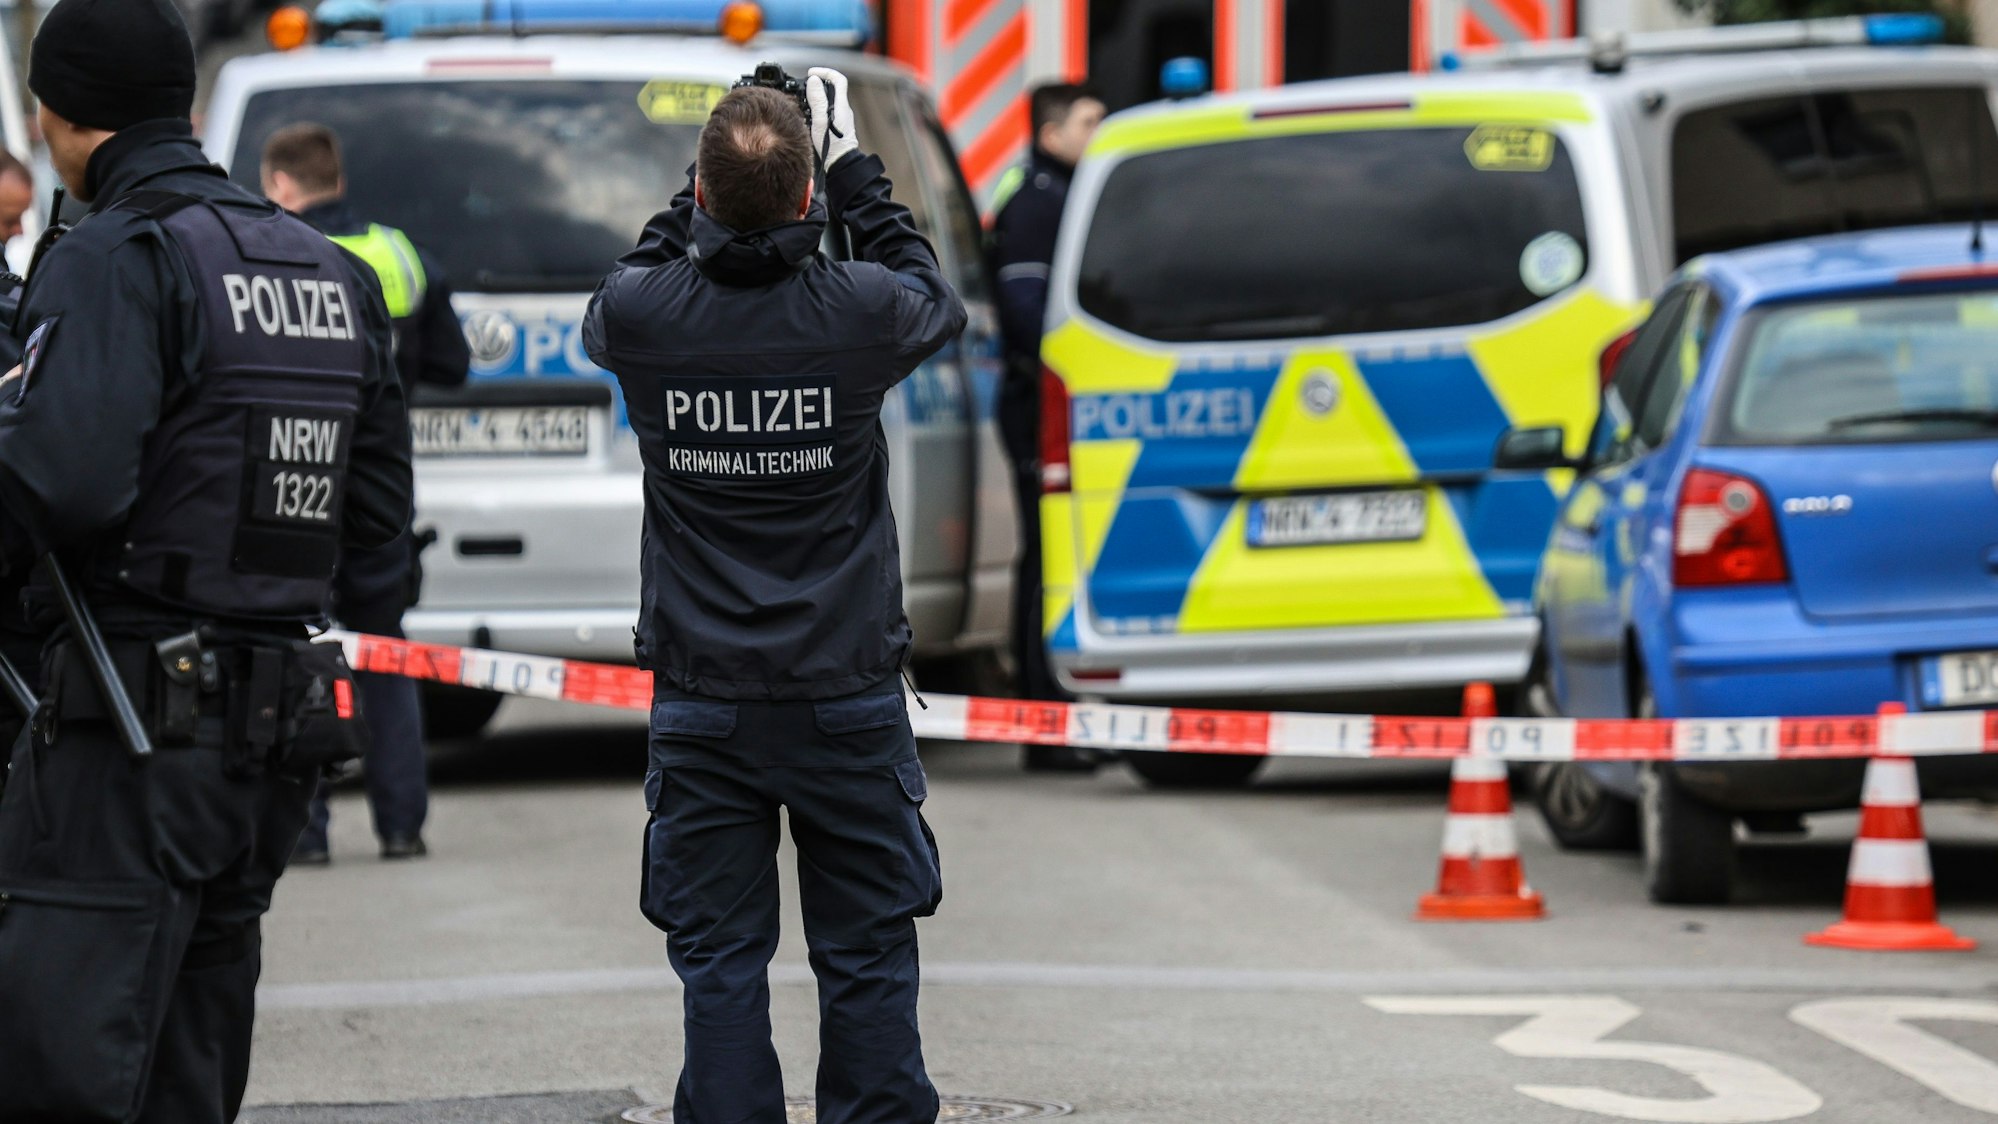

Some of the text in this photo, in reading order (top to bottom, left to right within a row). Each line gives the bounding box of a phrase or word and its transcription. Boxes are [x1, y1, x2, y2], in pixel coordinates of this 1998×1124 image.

[223, 274, 355, 340] POLIZEI
[666, 387, 832, 432] POLIZEI
[1073, 388, 1254, 438] POLIZEI
[269, 417, 340, 463] NRW
[669, 446, 833, 475] KRIMINALTECHNIK
[273, 471, 332, 519] 1322
